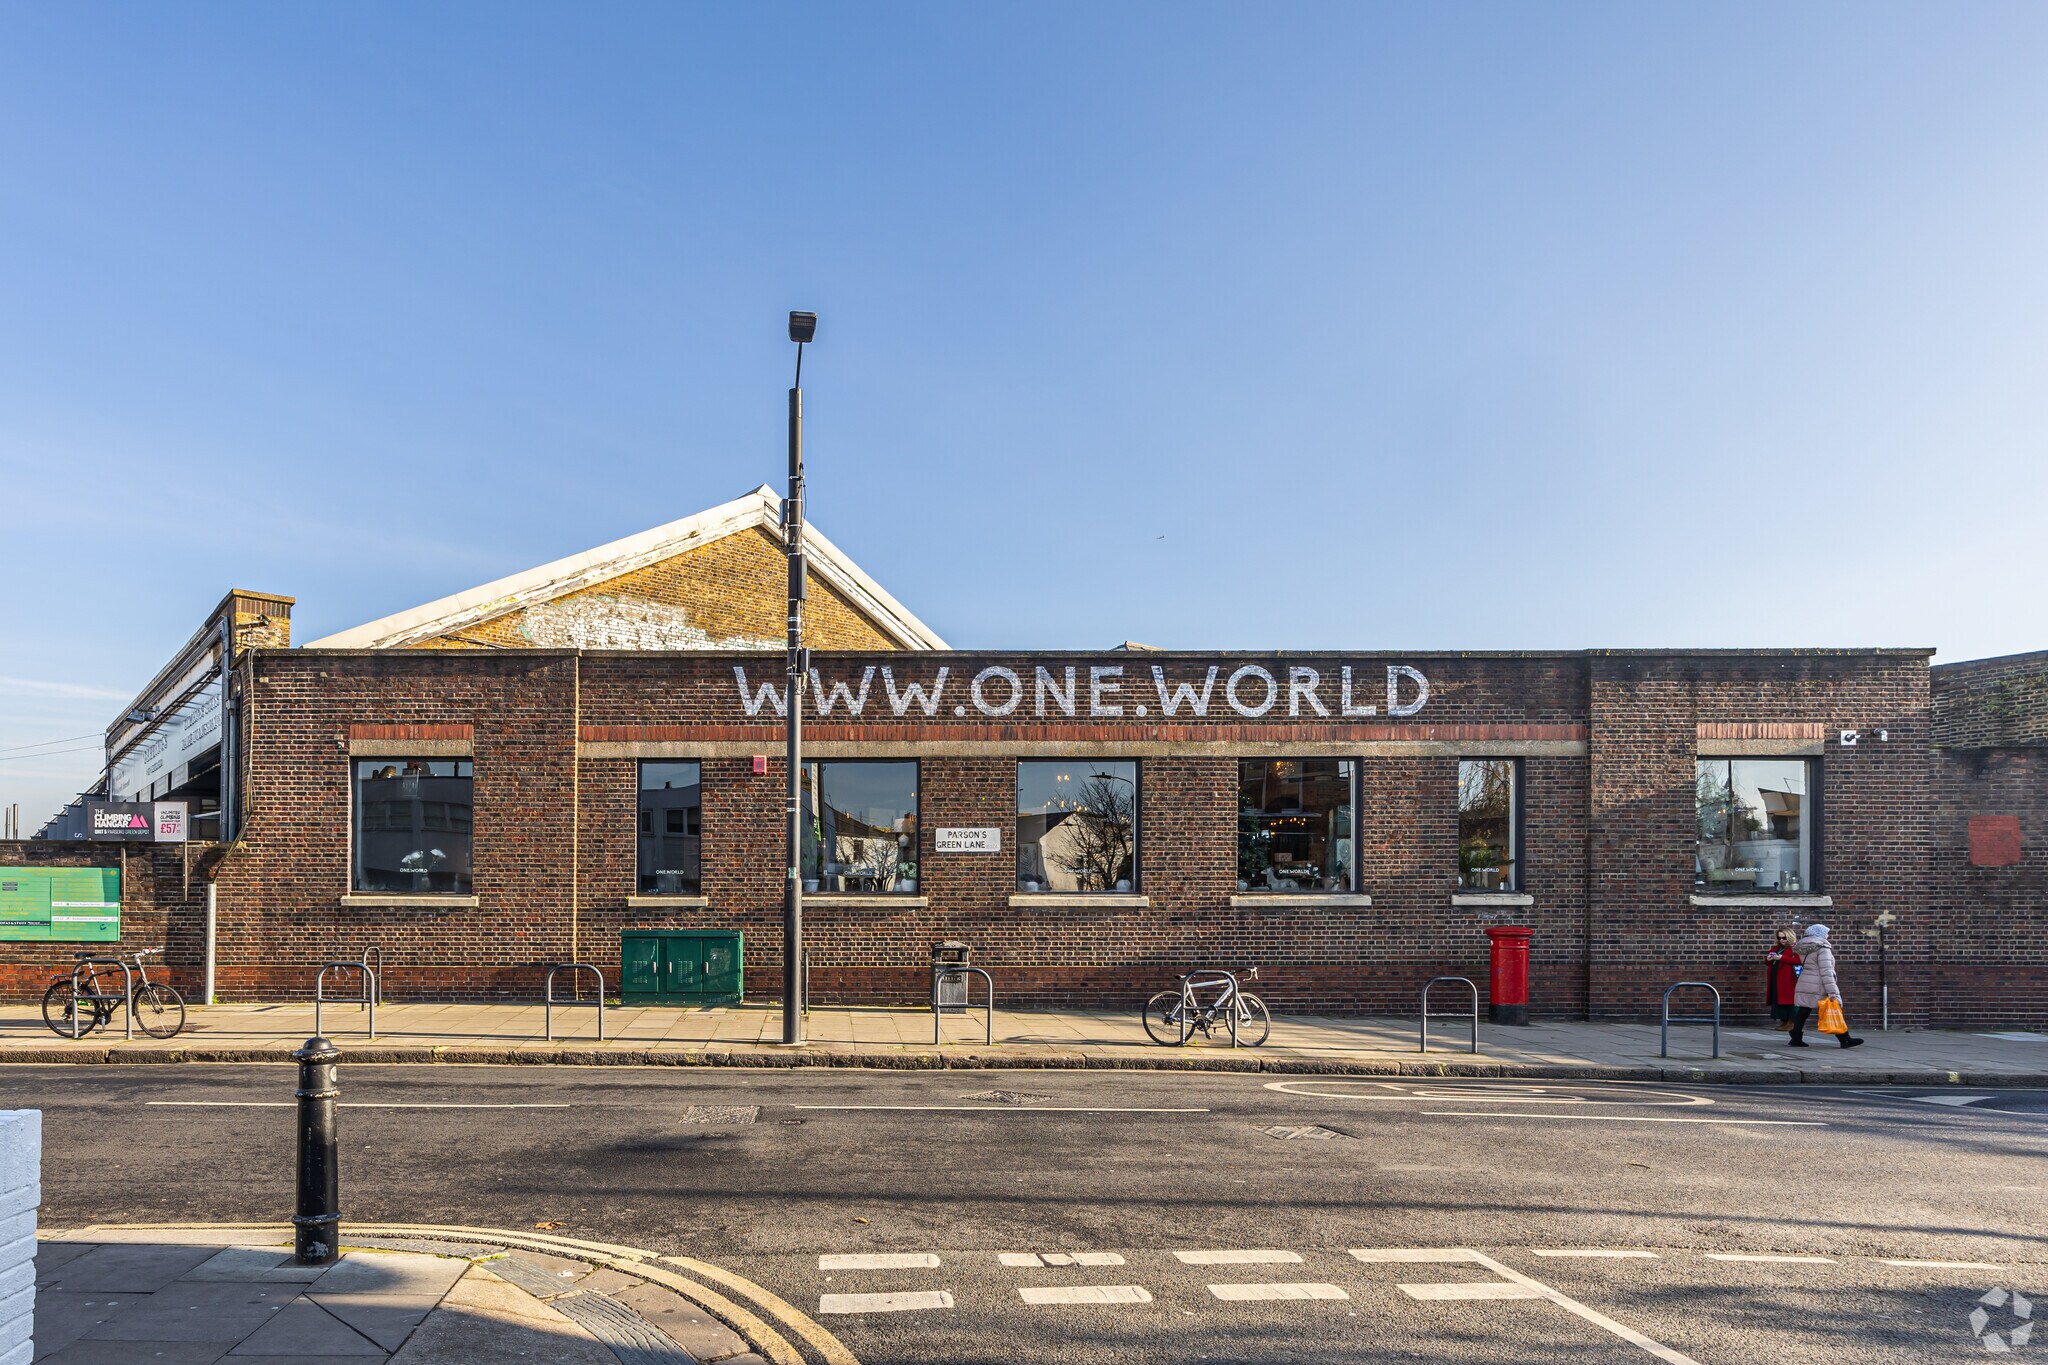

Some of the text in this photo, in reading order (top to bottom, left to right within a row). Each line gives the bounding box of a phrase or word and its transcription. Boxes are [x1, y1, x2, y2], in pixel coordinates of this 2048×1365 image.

[732, 665, 1430, 717] WWW.ONE.WORLD
[94, 813, 132, 821] CLIMBING
[94, 820, 129, 828] HANGAR
[160, 823, 177, 834] £57
[947, 831, 987, 839] PARSON'S
[936, 840, 962, 849] GREEN
[964, 840, 986, 849] LANE
